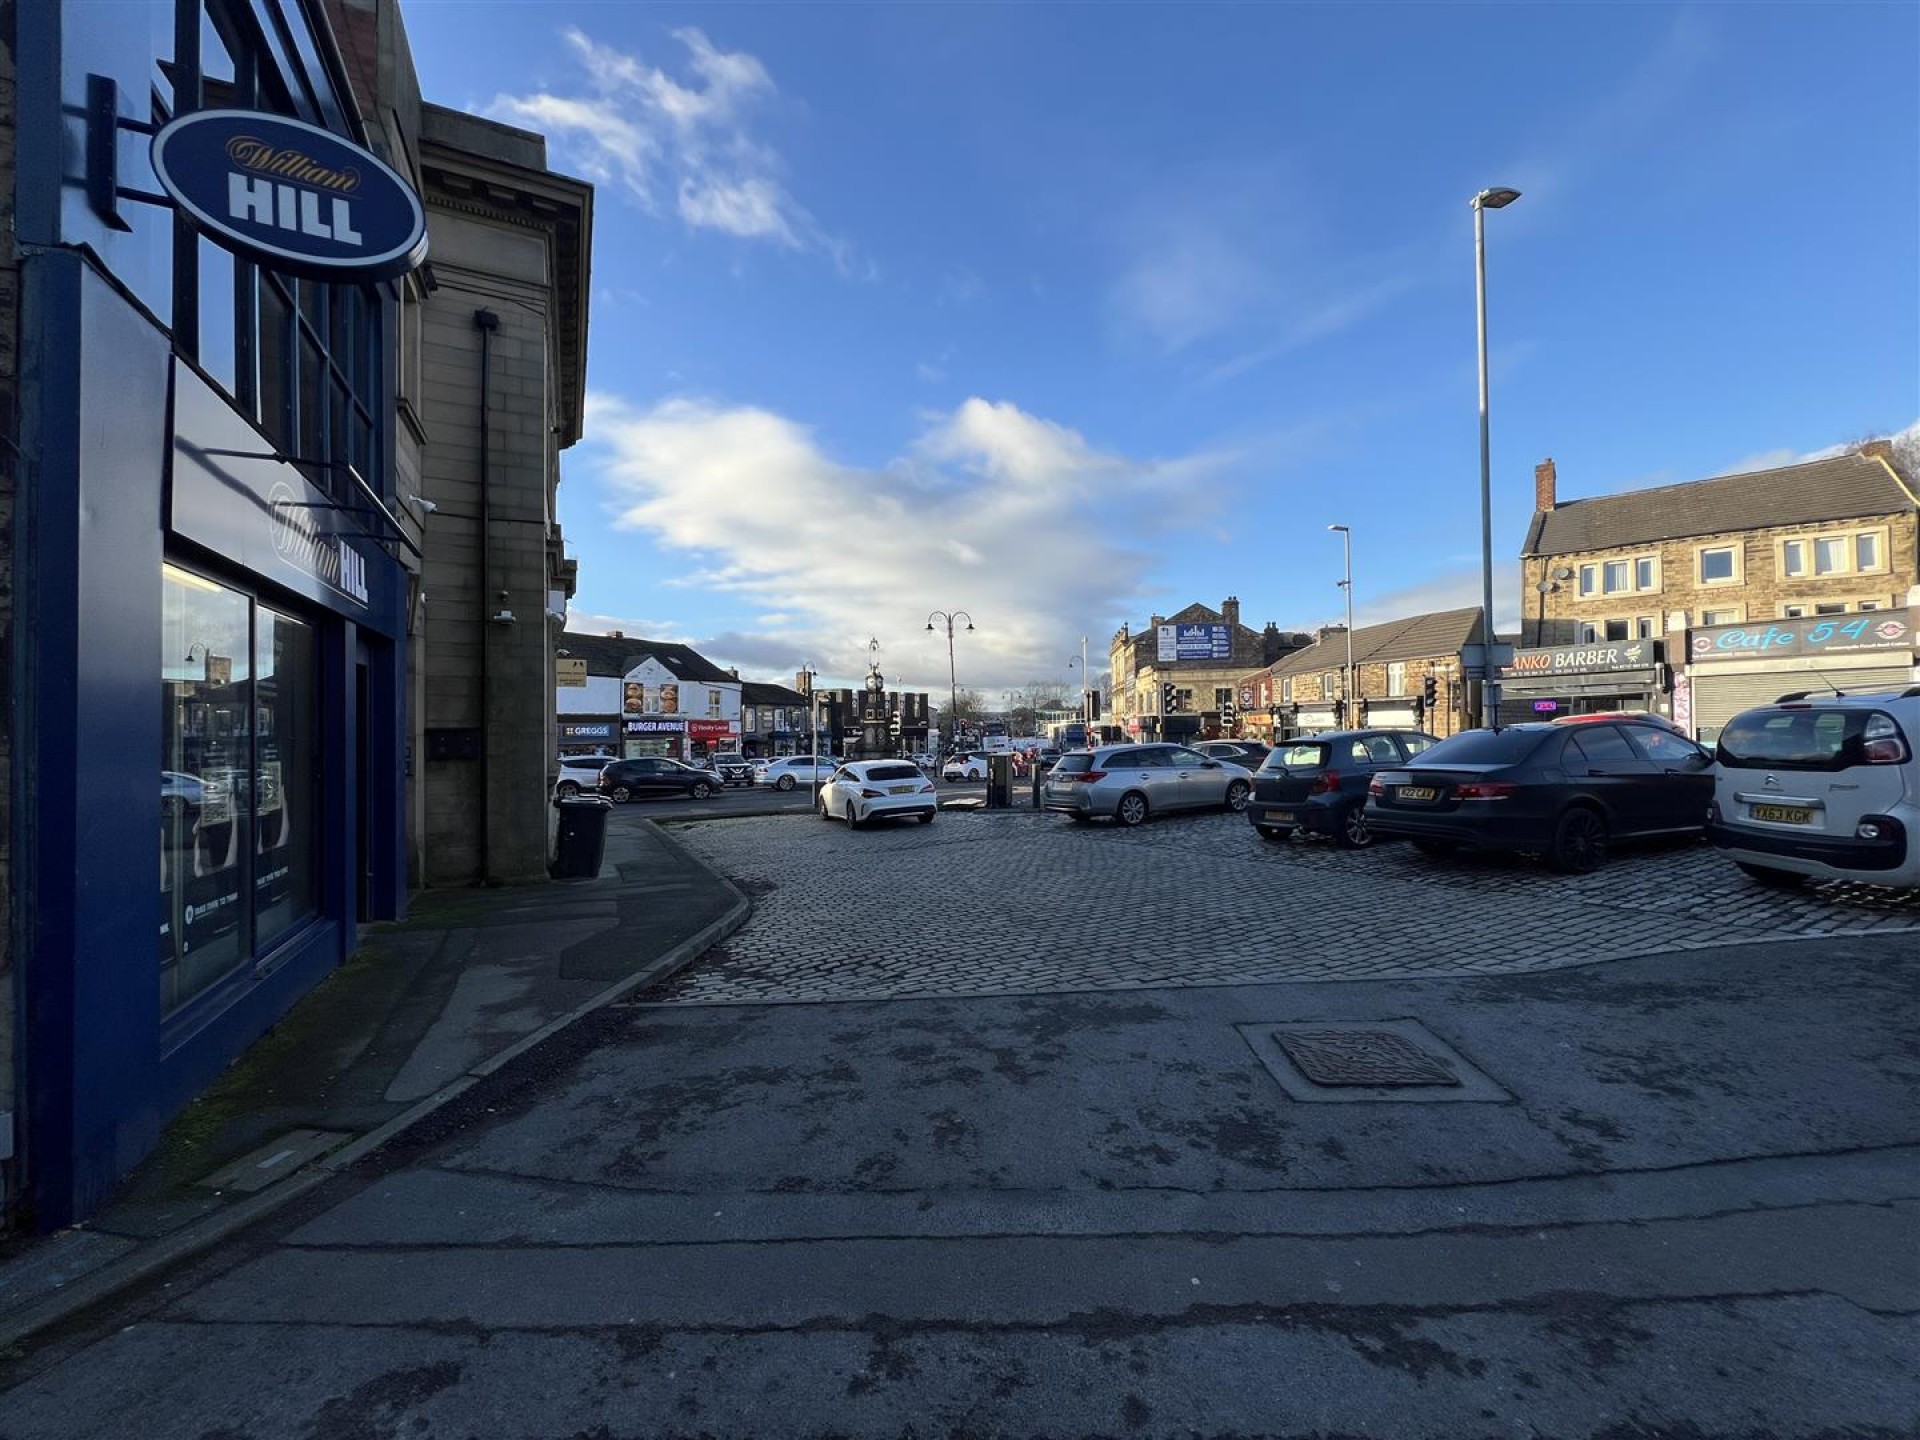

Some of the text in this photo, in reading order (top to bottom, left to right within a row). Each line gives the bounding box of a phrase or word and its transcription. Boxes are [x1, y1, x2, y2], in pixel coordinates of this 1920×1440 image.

[225, 135, 361, 194] William
[228, 171, 363, 246] HILL
[268, 481, 369, 604] William HILL
[1715, 618, 1869, 650] Cafe 54
[1502, 649, 1617, 670] ANKO BARBER
[574, 726, 608, 735] GREGGS
[627, 721, 685, 732] BURGER AVENUE
